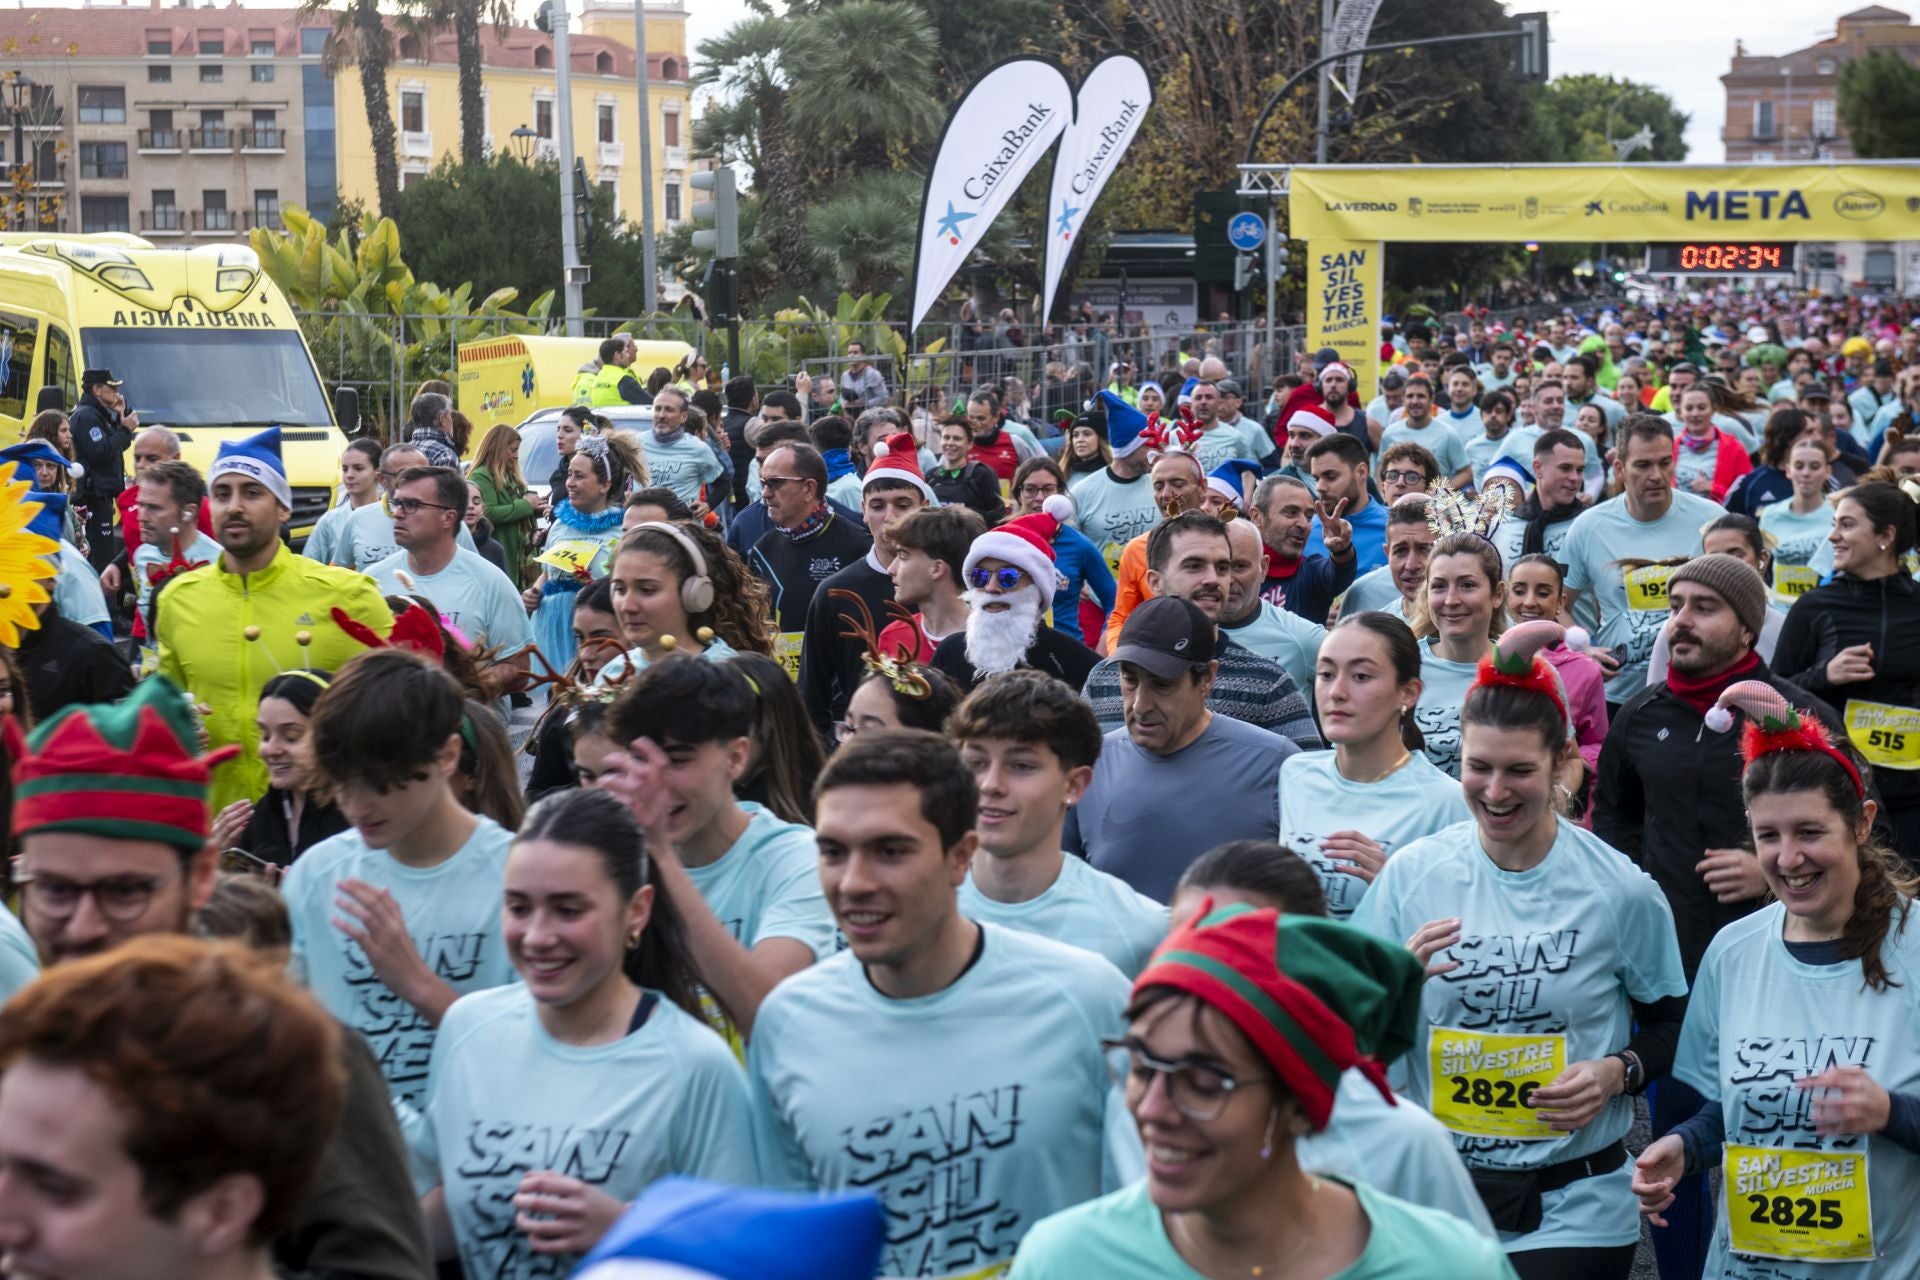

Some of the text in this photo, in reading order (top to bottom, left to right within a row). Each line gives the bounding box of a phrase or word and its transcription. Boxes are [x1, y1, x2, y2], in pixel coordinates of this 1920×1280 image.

[963, 103, 1052, 200] CaixaBank
[1071, 99, 1140, 195] CaixaBank
[1325, 203, 1398, 211] LA VERDAD
[1685, 190, 1811, 220] META
[1320, 249, 1366, 271] SAN
[1681, 245, 1780, 269] 0:02:34
[1327, 269, 1359, 288] SIL
[1323, 283, 1364, 304] VES
[1323, 300, 1365, 322] TRE
[1321, 317, 1369, 334] MURCIA
[1855, 707, 1885, 719] SAN
[1868, 730, 1905, 751] 515
[1440, 929, 1580, 983] SAN
[1458, 977, 1553, 1028] SIL
[1440, 1040, 1555, 1076] SILVESTRE
[1441, 1039, 1482, 1058] SAN
[1730, 1033, 1877, 1085] SAN
[1503, 1062, 1553, 1078] MURCIA
[842, 1084, 1026, 1186] SAN
[457, 1120, 631, 1184] SAN
[1736, 1158, 1857, 1195] SILVESTRE
[1737, 1154, 1781, 1176] SAN
[1804, 1178, 1856, 1197] MURCIA
[1748, 1193, 1844, 1230] 2825
